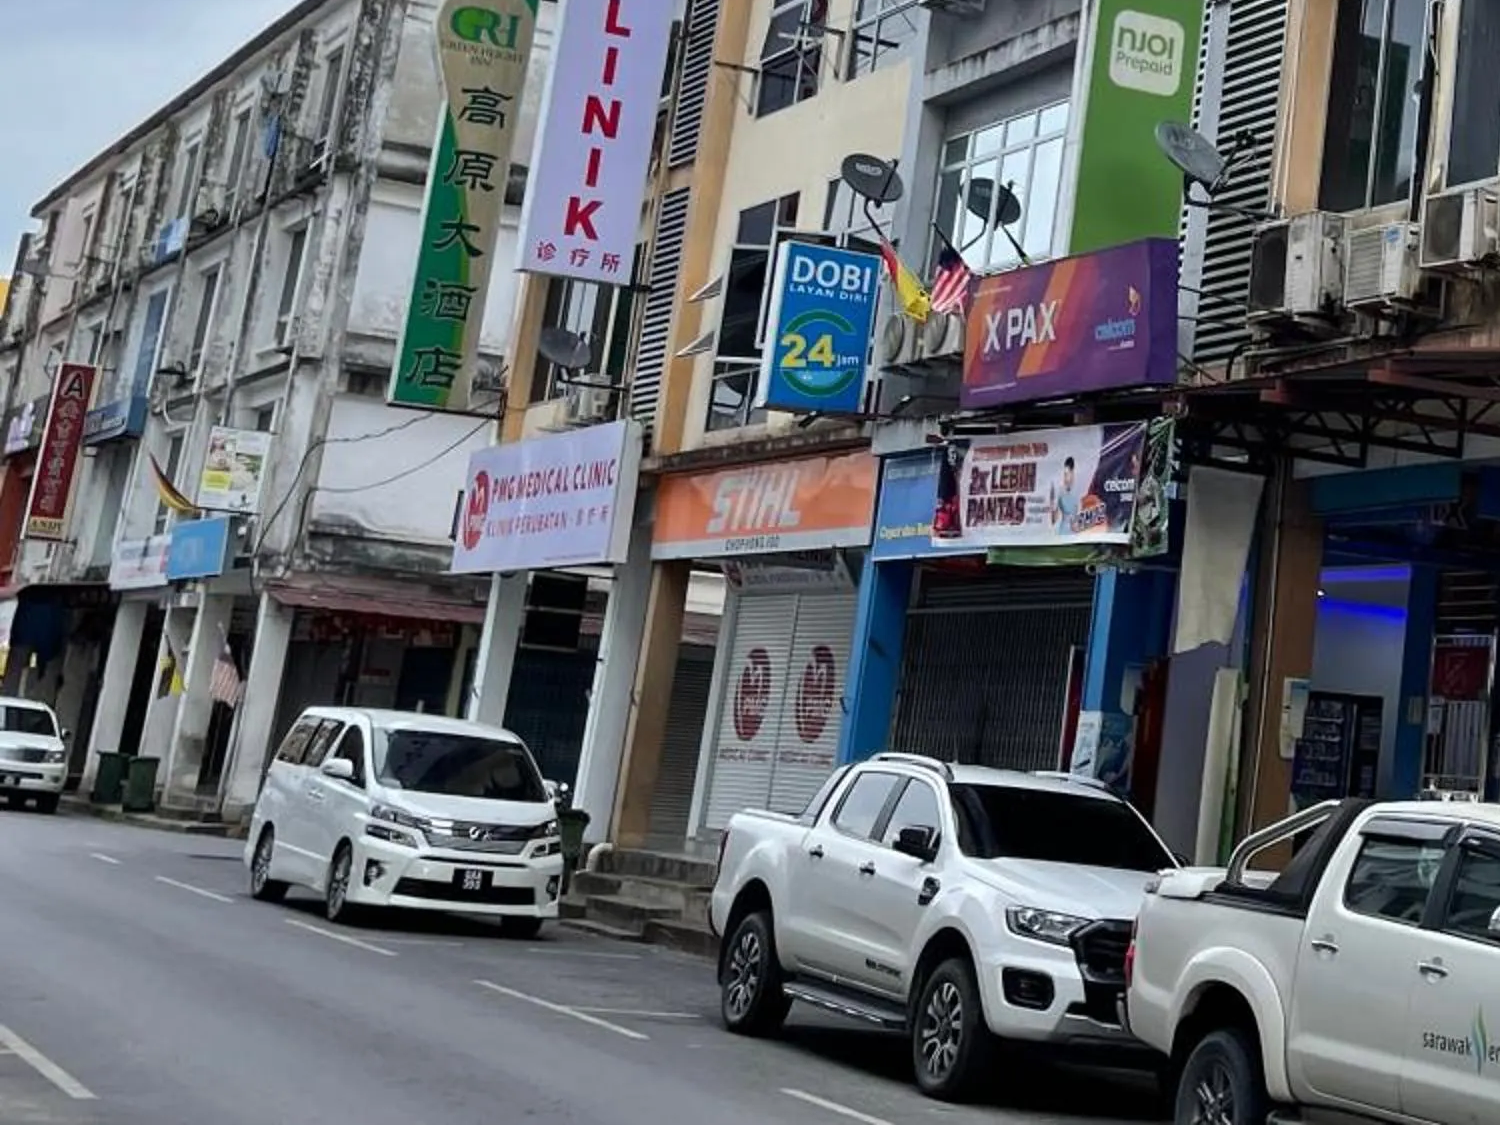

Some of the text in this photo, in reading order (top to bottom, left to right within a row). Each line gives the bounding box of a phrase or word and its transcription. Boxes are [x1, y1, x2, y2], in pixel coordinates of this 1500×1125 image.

[1116, 50, 1173, 76] Prepaid
[405, 85, 513, 388] 高原大酒店
[536, 240, 622, 273] 诊疗所
[792, 256, 872, 294] DOBI
[789, 283, 868, 303] LAYAN DIRI
[781, 333, 860, 368] 24 jam
[516, 466, 569, 500] MEDICAL
[573, 458, 617, 491] CLINIC
[990, 462, 1037, 493] LEBIH
[706, 469, 801, 534] STIHL
[966, 495, 1027, 527] PANTAS
[1423, 1031, 1473, 1056] sarawak
